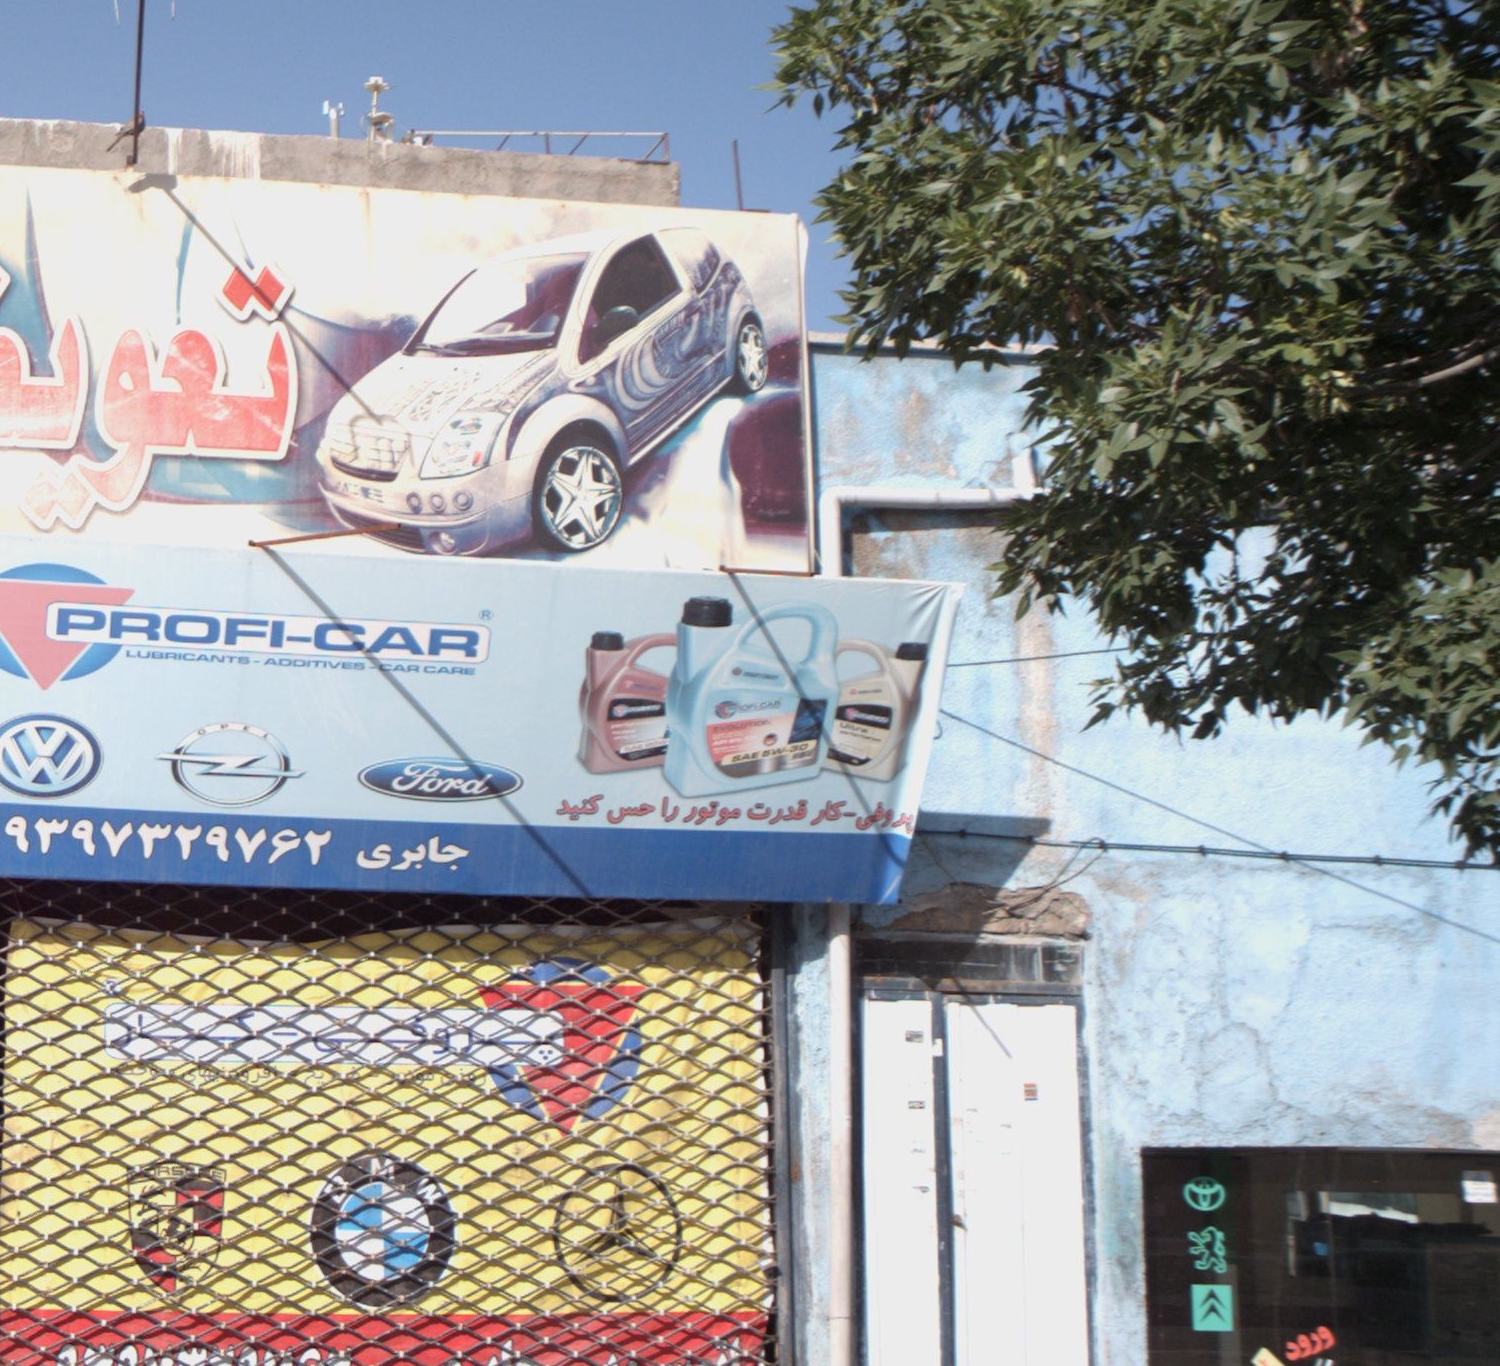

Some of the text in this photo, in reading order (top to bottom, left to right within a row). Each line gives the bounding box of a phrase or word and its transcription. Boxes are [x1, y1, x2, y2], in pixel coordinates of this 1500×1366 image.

[55, 607, 480, 658] PROFI-CAR
[125, 649, 476, 676] LUBRICANTS ADDITIVES CAR CARE
[391, 762, 493, 795] Ford
[556, 795, 604, 816] کنید
[606, 803, 656, 825] حس
[660, 796, 680, 823] را
[683, 800, 741, 826] موتور
[747, 799, 809, 825] قدرت
[356, 835, 470, 871] جابری
[1284, 1325, 1336, 1362] ورود
